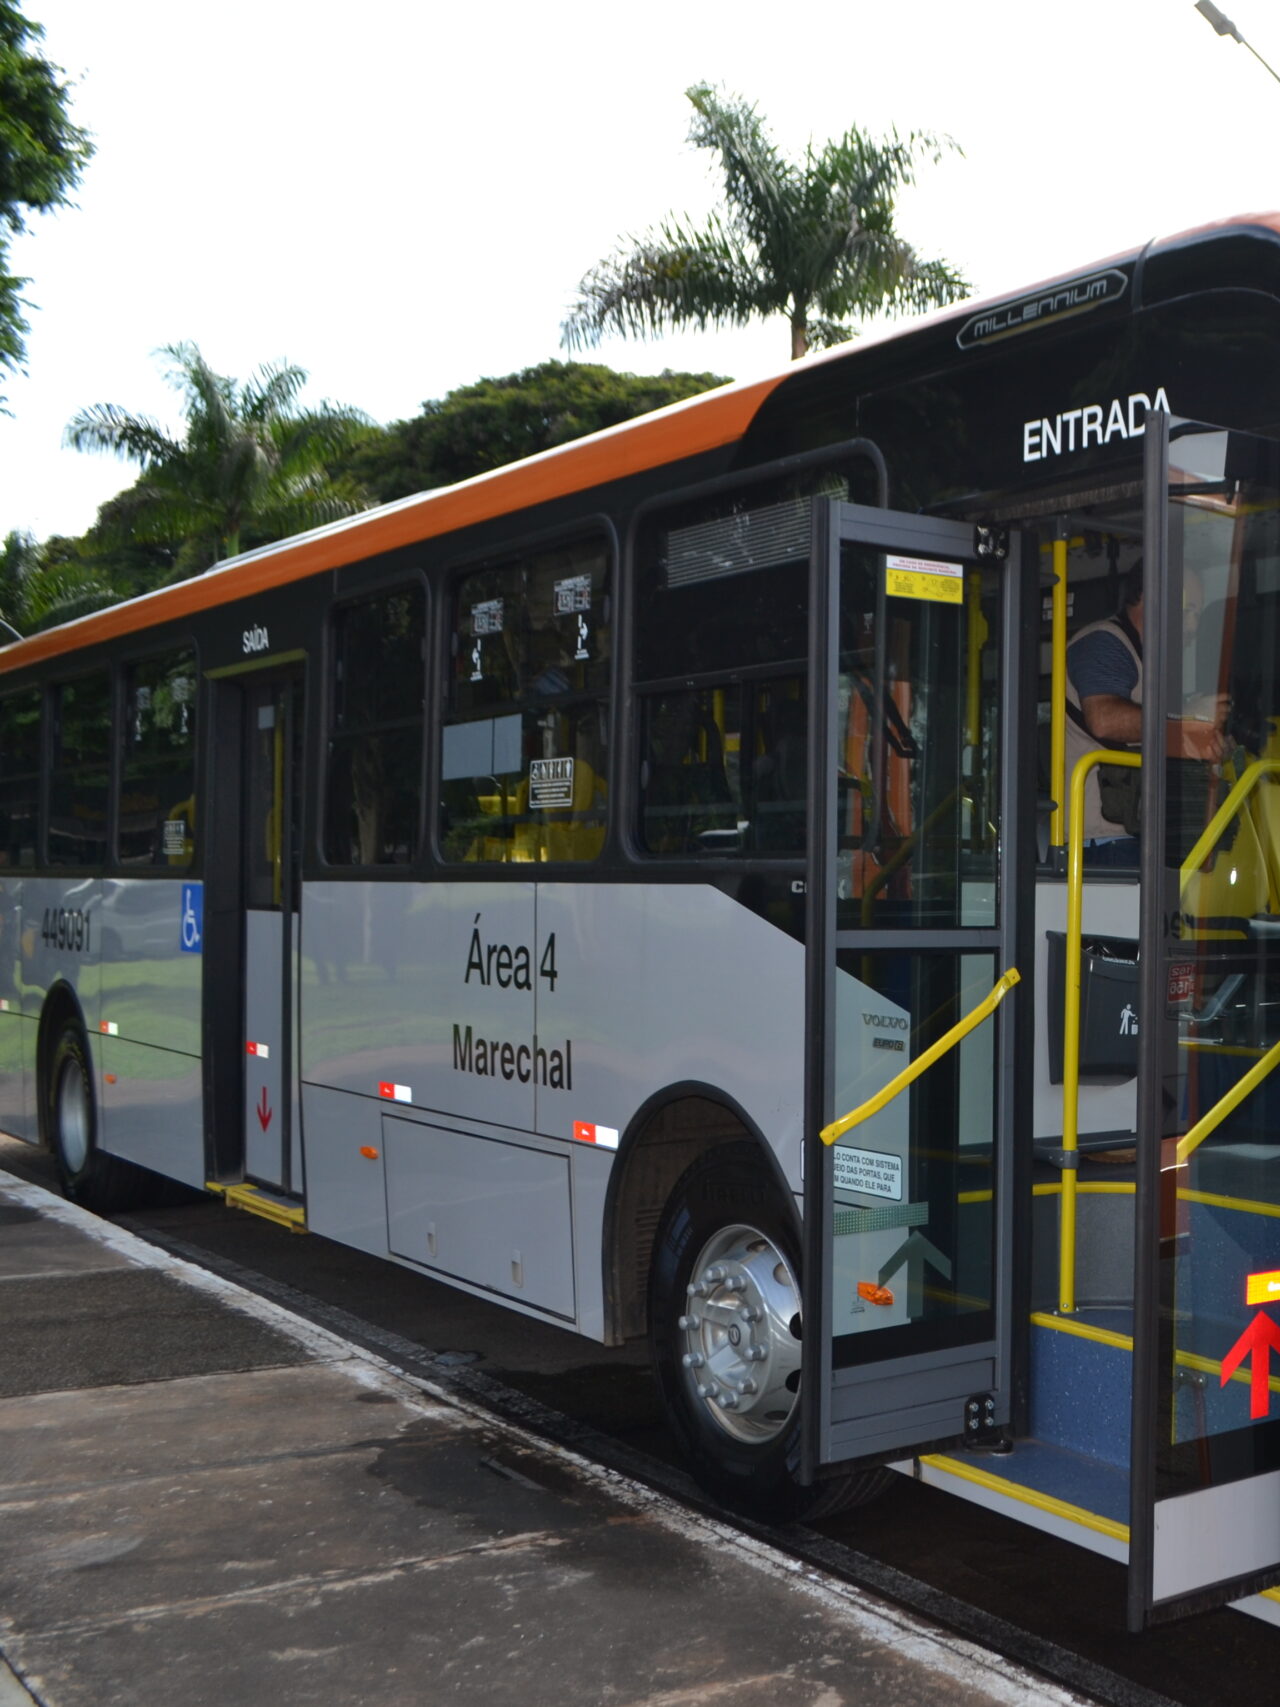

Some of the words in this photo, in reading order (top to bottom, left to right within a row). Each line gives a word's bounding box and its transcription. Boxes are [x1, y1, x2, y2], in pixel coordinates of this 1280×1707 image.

[974, 279, 1107, 337] MILLENNIUM
[242, 623, 269, 654] SAÍDA
[41, 906, 90, 953] 449091
[464, 912, 532, 991] Área
[540, 932, 558, 992] 4
[862, 1013, 908, 1030] VOLVO
[453, 1023, 572, 1091] Marechal
[842, 1153, 860, 1163] CONTA
[861, 1157, 875, 1167] COM
[875, 1160, 899, 1171] SISTEMA
[846, 1165, 858, 1174] DAS
[883, 1172, 896, 1182] QUE
[840, 1176, 864, 1187] QUANDO
[864, 1180, 876, 1190] ELE
[876, 1183, 892, 1193] PARA
